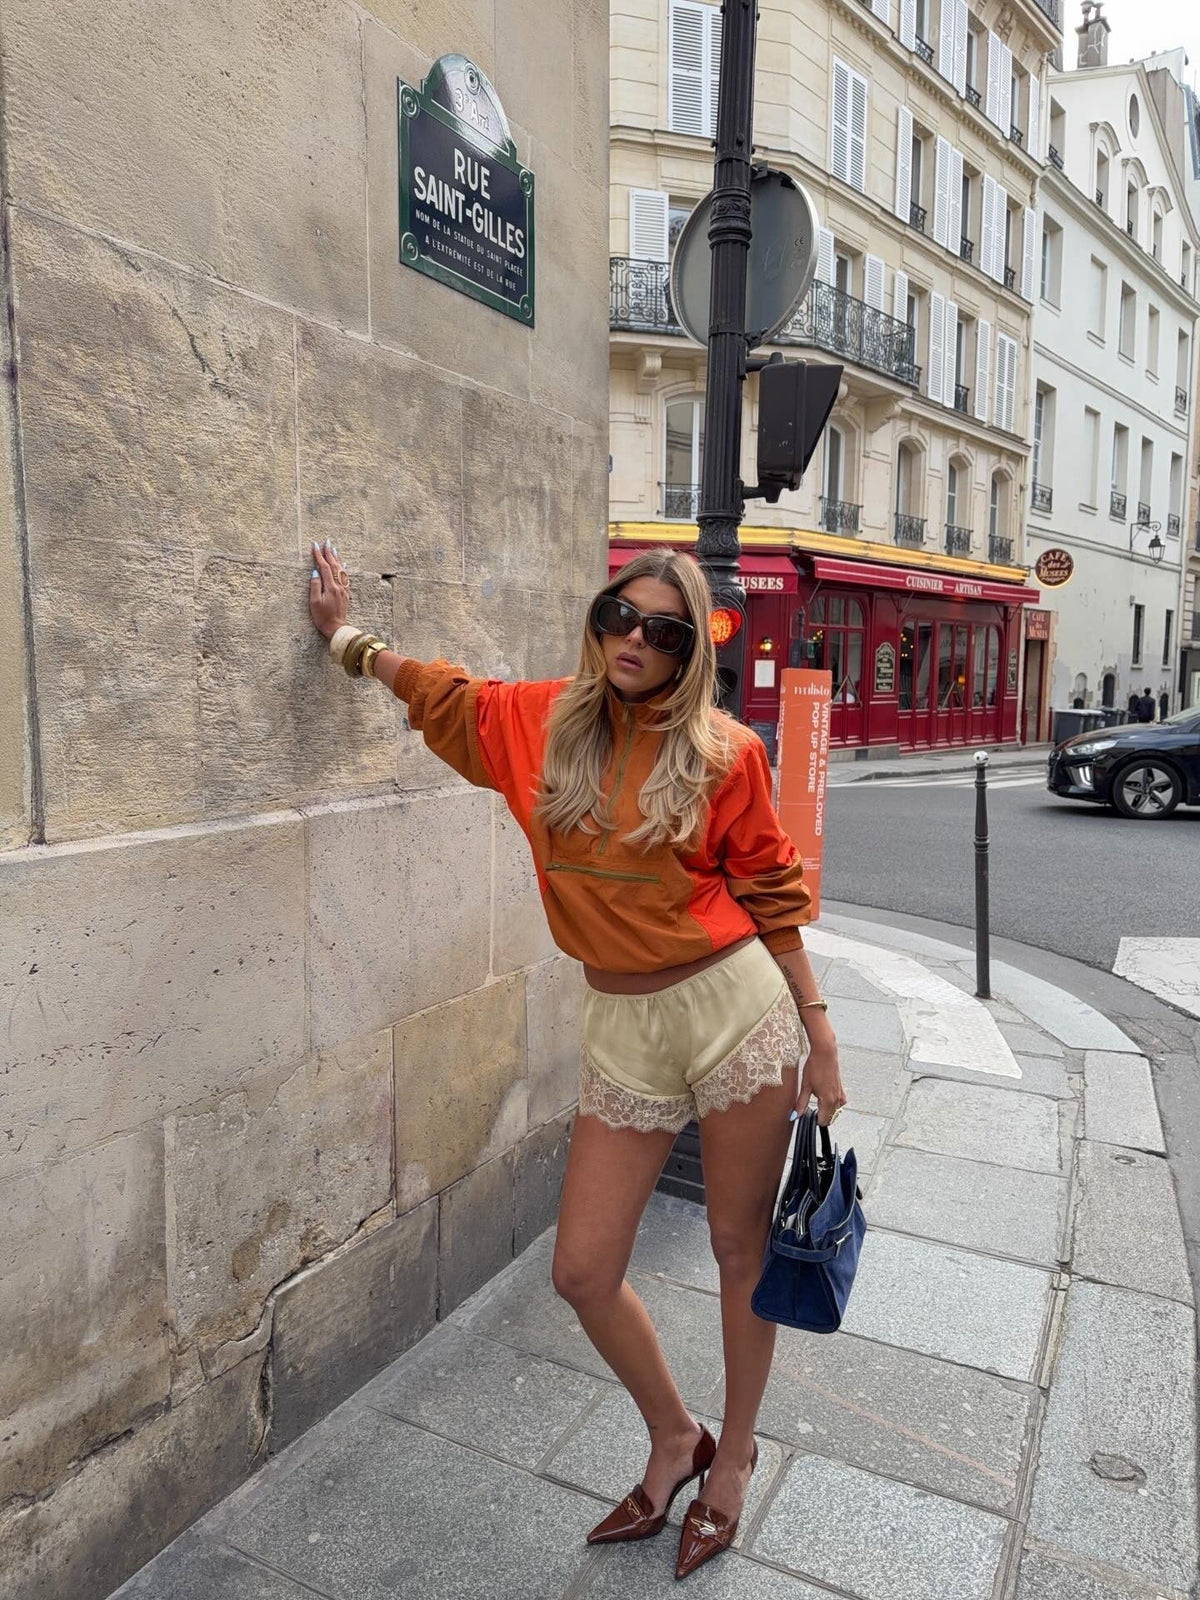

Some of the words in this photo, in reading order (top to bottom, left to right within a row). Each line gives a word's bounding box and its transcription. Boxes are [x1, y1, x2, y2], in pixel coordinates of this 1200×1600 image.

[454, 147, 491, 200] RUE
[414, 166, 525, 259] SAINT-GILLES
[415, 208, 430, 224] NOM
[432, 218, 441, 231] DE
[443, 225, 451, 236] LA
[453, 231, 474, 249] STATUE
[476, 244, 485, 255] DU
[487, 250, 502, 264] SAINT
[504, 260, 523, 277] PLACÉE
[432, 239, 471, 267] L'EXTRÉMITÉ
[473, 261, 484, 274] EST
[486, 268, 494, 279] DE
[496, 273, 504, 285] LA
[505, 278, 516, 291] RUE
[905, 575, 944, 592] CUISINIER
[954, 581, 983, 596] ARTISAN
[1047, 560, 1061, 568] des
[811, 702, 820, 728] POP
[819, 702, 830, 755] VINTAGE
[810, 732, 818, 749] UP
[818, 759, 826, 768] &
[807, 752, 818, 793] STORE
[815, 771, 826, 836] PRELOVED
